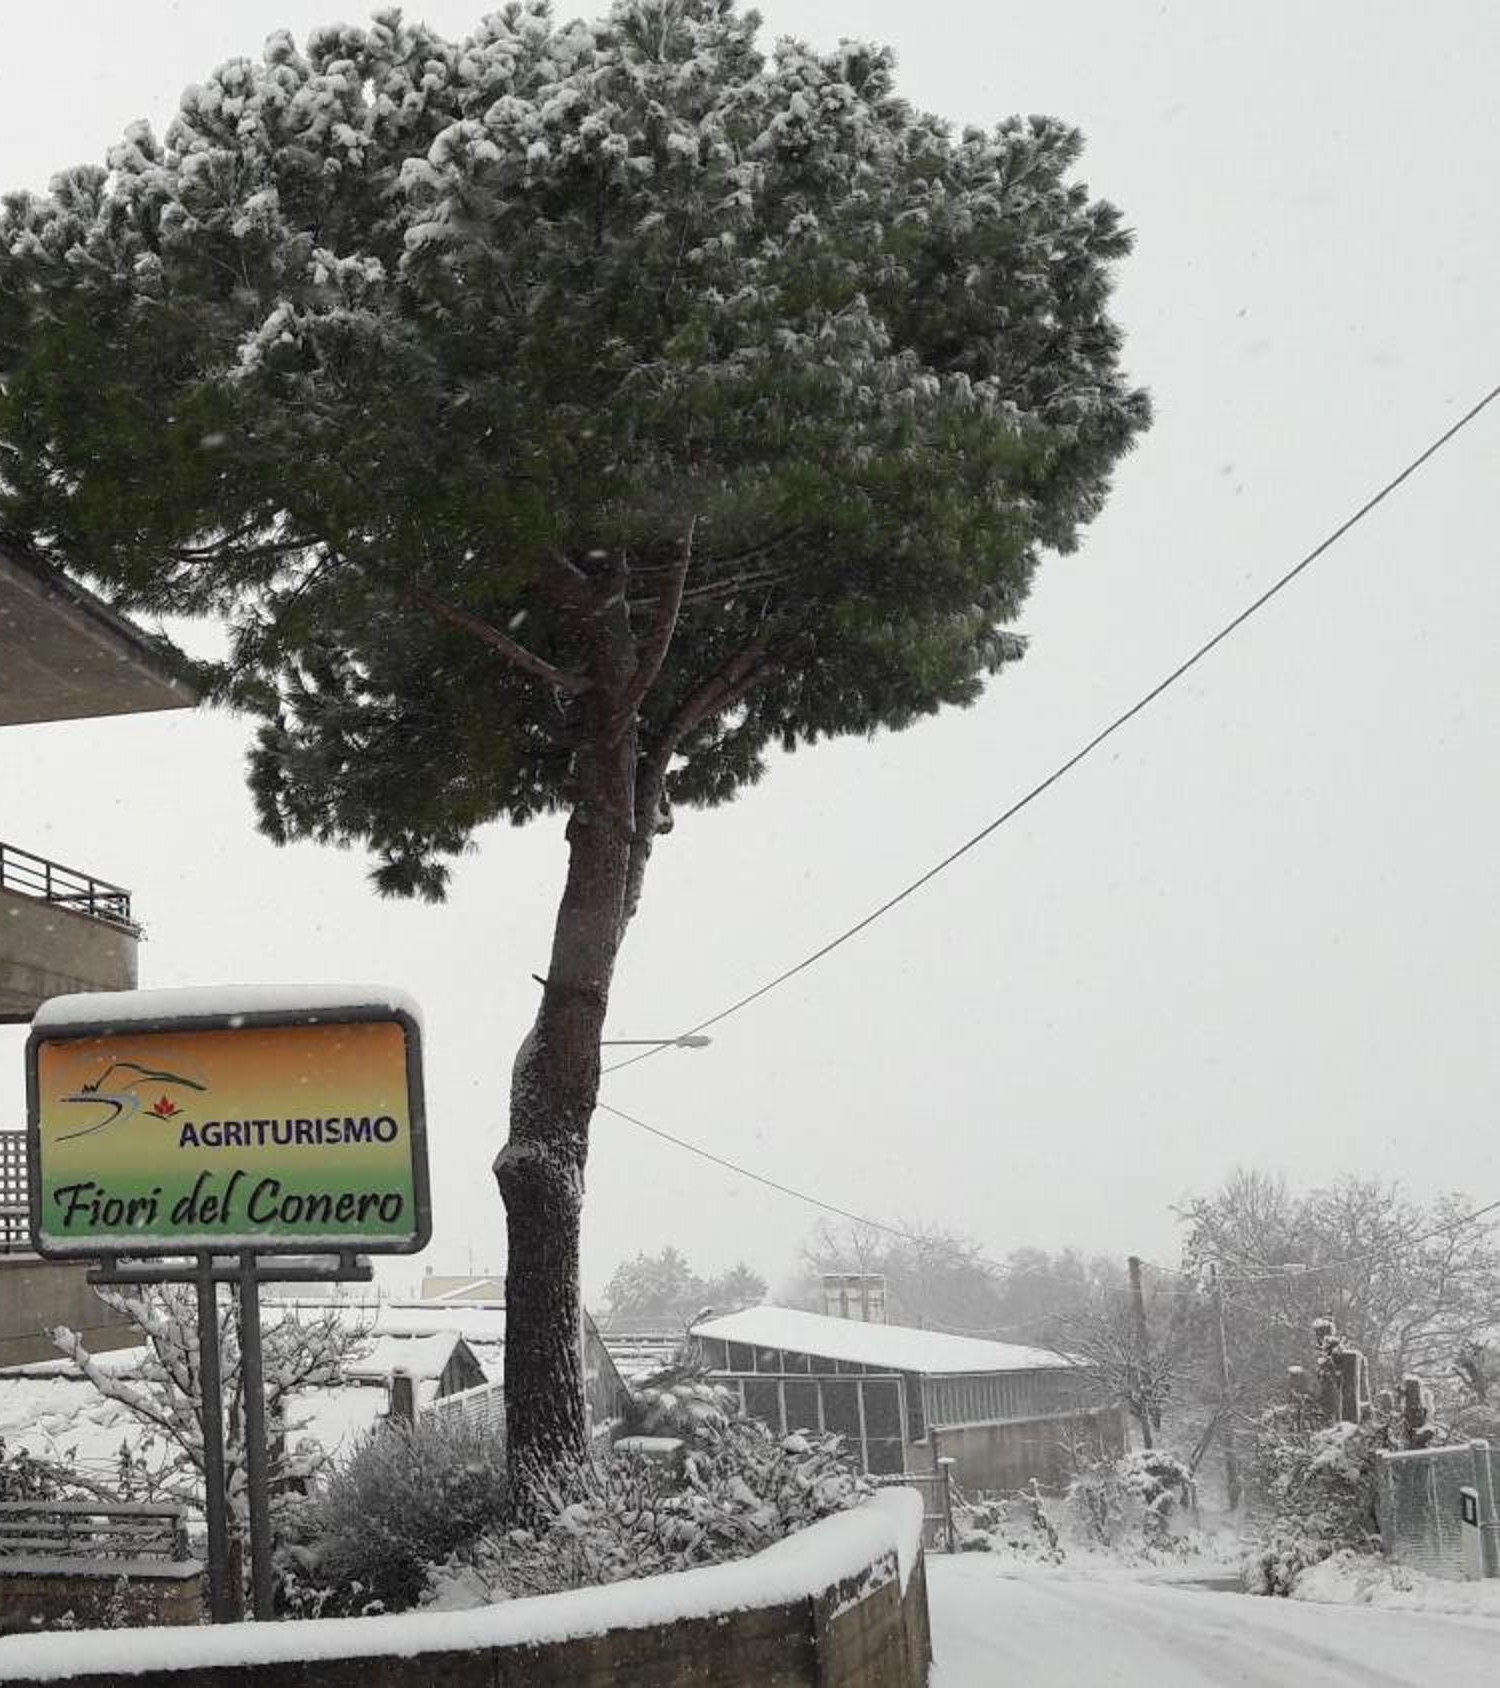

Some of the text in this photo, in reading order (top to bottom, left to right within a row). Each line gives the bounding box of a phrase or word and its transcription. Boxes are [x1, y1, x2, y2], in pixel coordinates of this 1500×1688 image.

[179, 1116, 399, 1148] AGRITURISMO
[53, 1169, 403, 1228] Fiori del Conero
